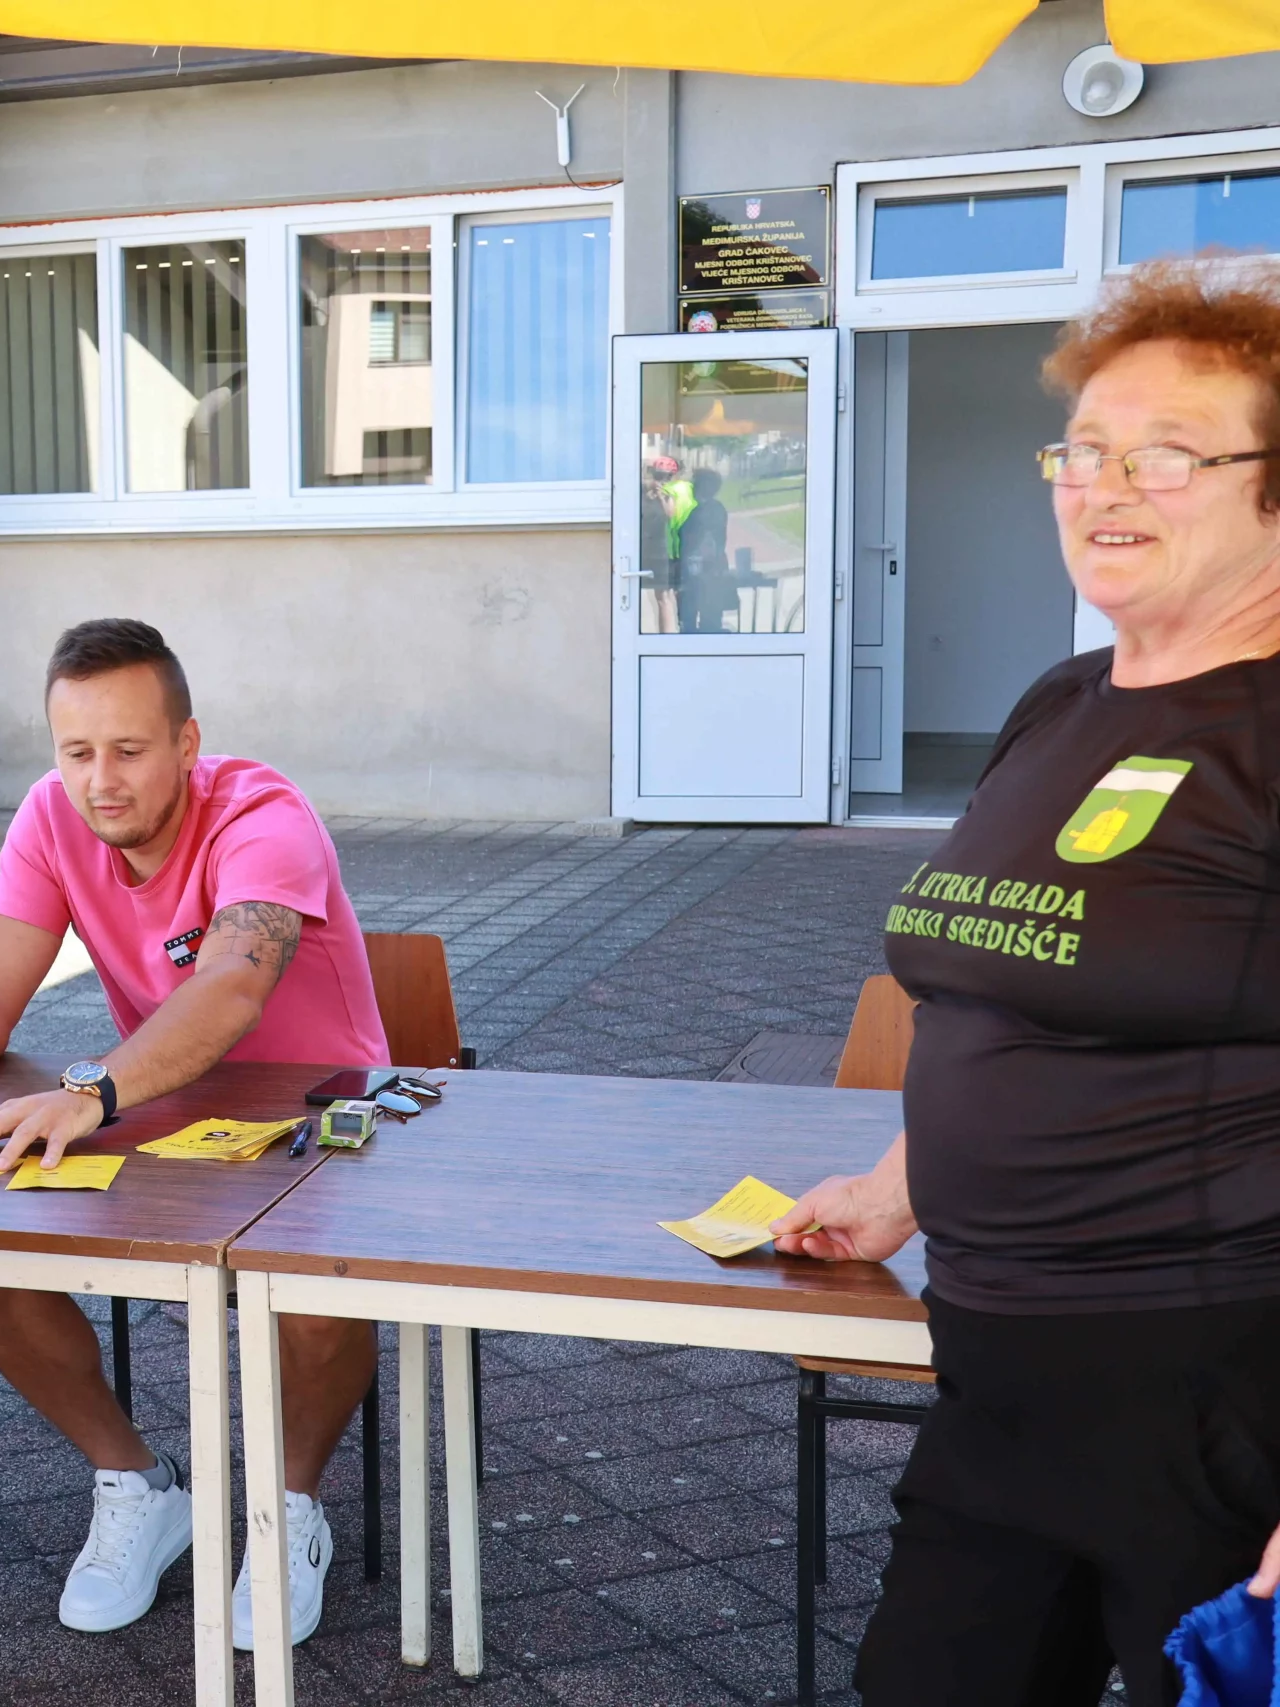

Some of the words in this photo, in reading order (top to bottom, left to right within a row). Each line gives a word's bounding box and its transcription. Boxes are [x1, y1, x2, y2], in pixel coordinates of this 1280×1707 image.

[711, 223, 754, 233] REPUBLIKA
[755, 220, 795, 229] HRVATSKA
[762, 231, 805, 242] ŽUPANIJA
[718, 248, 744, 258] GRAD
[745, 245, 789, 256] ČAKOVEC
[694, 260, 725, 269] MJESNI
[725, 258, 755, 267] ODBOR
[756, 254, 813, 266] KRIŠTANOVEC
[701, 267, 729, 278] VIJEĆE
[730, 266, 770, 276] MJESNOG
[770, 264, 806, 274] ODBORA
[722, 273, 785, 286] KRIŠTANOVEC
[918, 871, 988, 904] UTRKA
[989, 879, 1087, 920] GRADA
[166, 929, 200, 948] TOMMY
[885, 904, 944, 938] URSKO
[945, 915, 1081, 966] SREDIŠĆE
[178, 953, 198, 965] JEA
